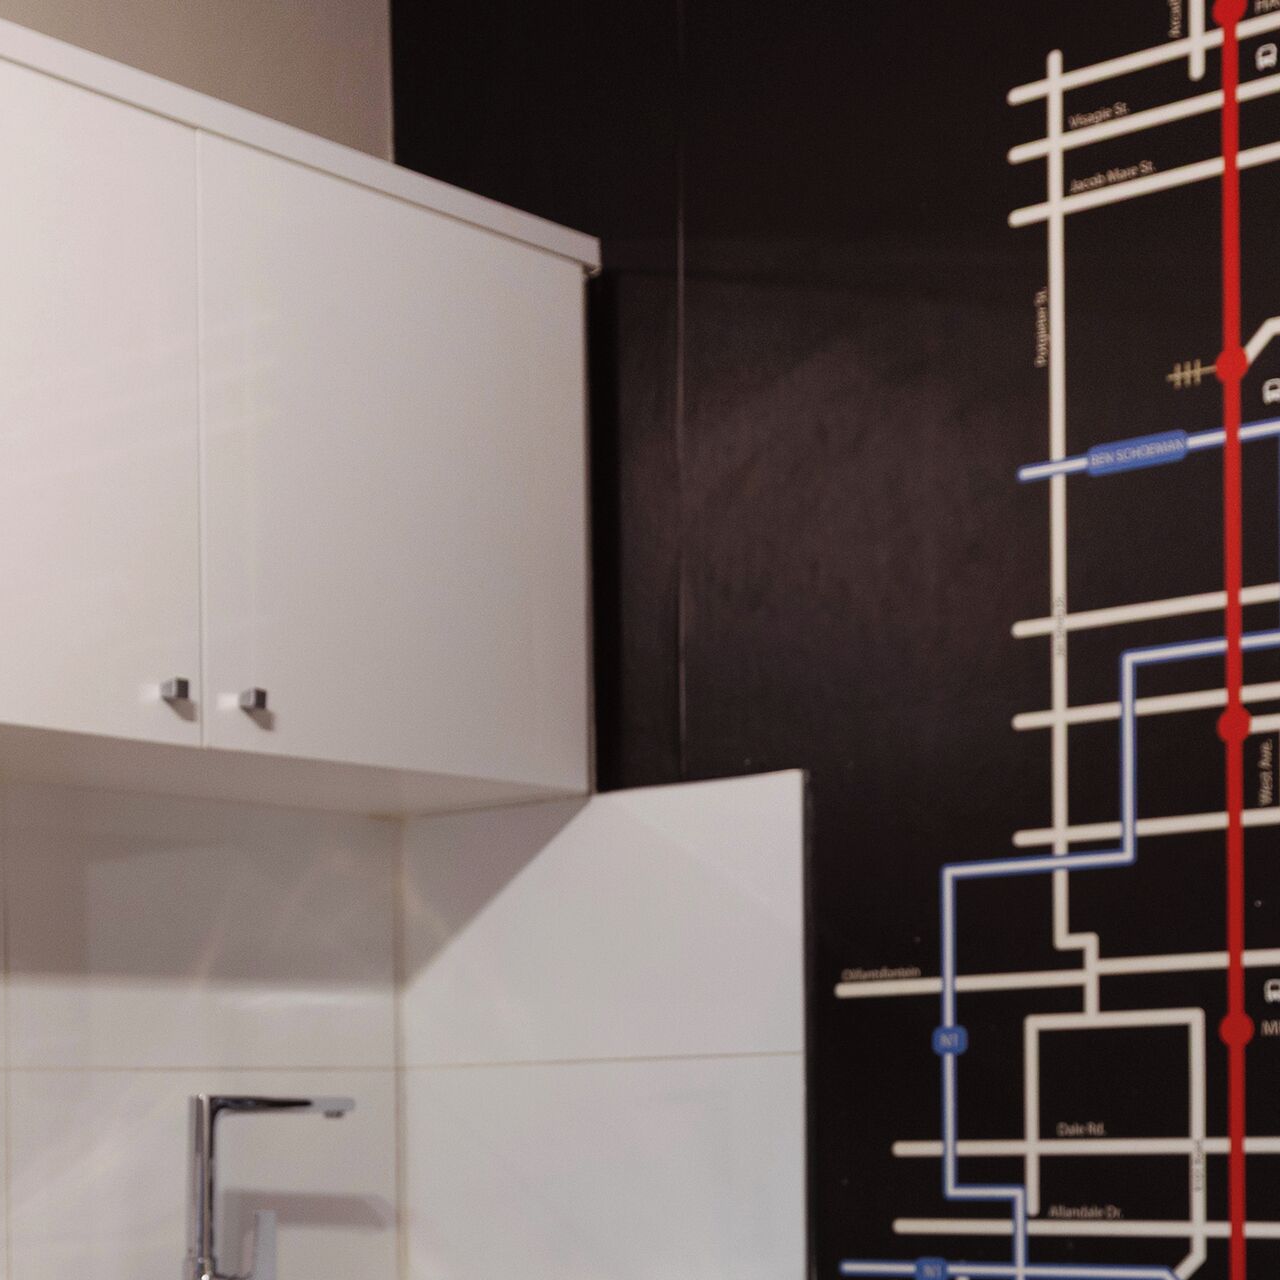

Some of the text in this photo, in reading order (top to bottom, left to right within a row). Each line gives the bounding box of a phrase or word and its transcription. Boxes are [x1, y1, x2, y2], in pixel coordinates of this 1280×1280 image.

[1090, 438, 1185, 466] BEN SCHOEMAN
[1056, 1121, 1085, 1136] Dale
